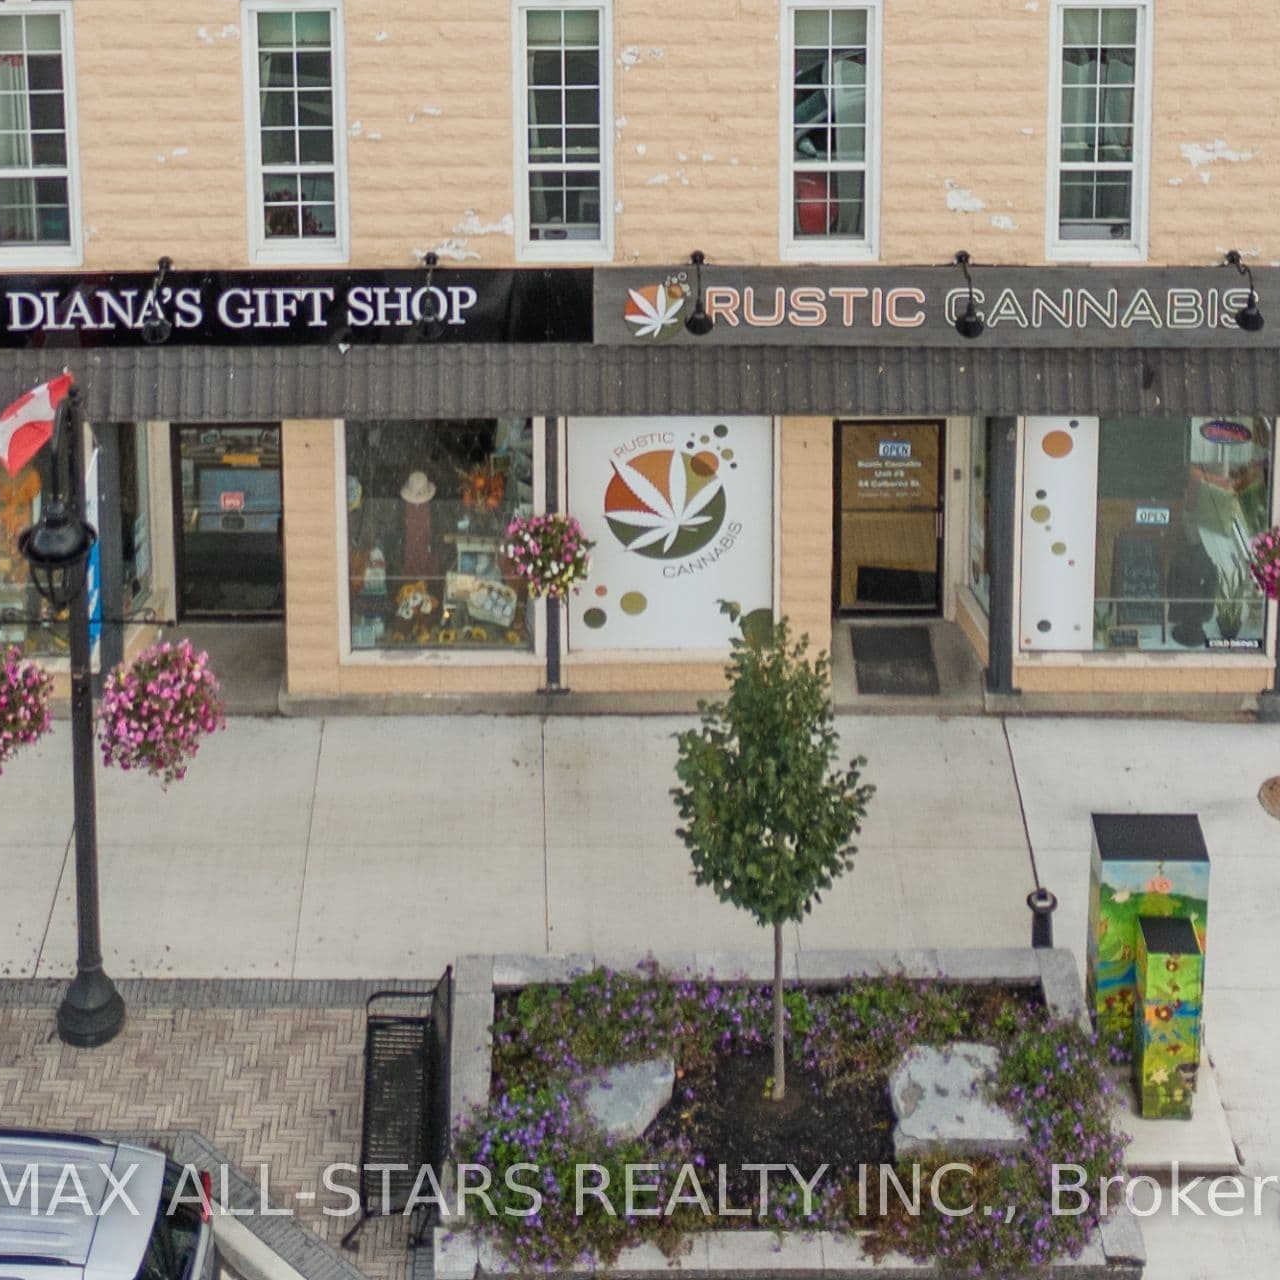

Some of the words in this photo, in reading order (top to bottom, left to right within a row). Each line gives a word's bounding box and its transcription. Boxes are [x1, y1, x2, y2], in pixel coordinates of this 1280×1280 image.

[6, 286, 203, 331] DIANA'S
[218, 286, 334, 328] GIFT
[346, 286, 477, 327] SHOP
[707, 286, 927, 328] RUSTIC
[944, 287, 1261, 329] CANNABIS
[613, 432, 675, 459] RUSTIC
[1140, 511, 1168, 522] OPEN
[661, 520, 743, 579] CANNABIS
